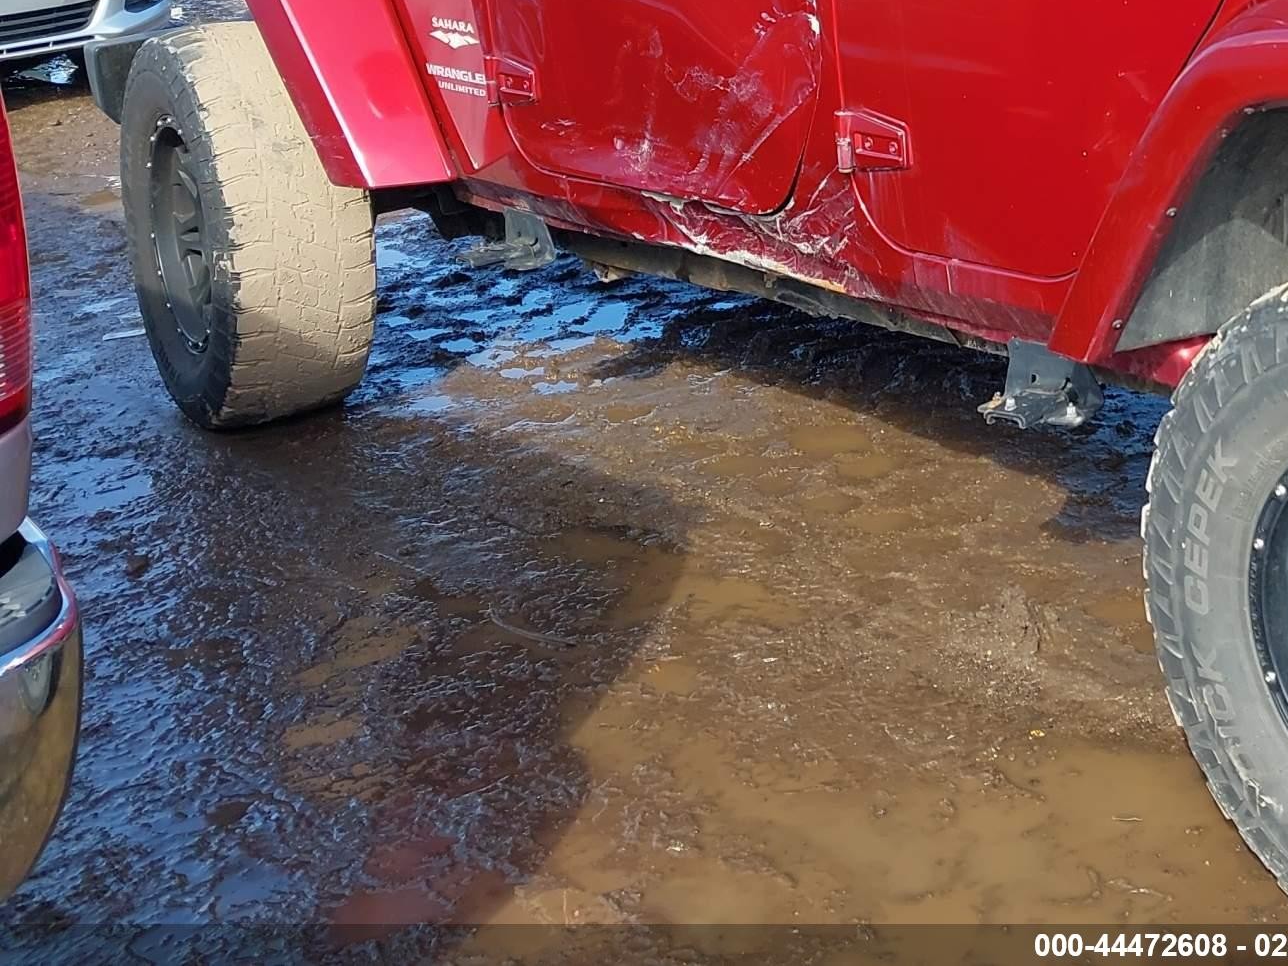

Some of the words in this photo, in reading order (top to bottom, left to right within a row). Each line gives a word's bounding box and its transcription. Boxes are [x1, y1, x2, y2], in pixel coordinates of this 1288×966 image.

[431, 16, 475, 34] SAHARA
[438, 80, 487, 97] UNLIMITED
[1184, 437, 1239, 615] CEPEK
